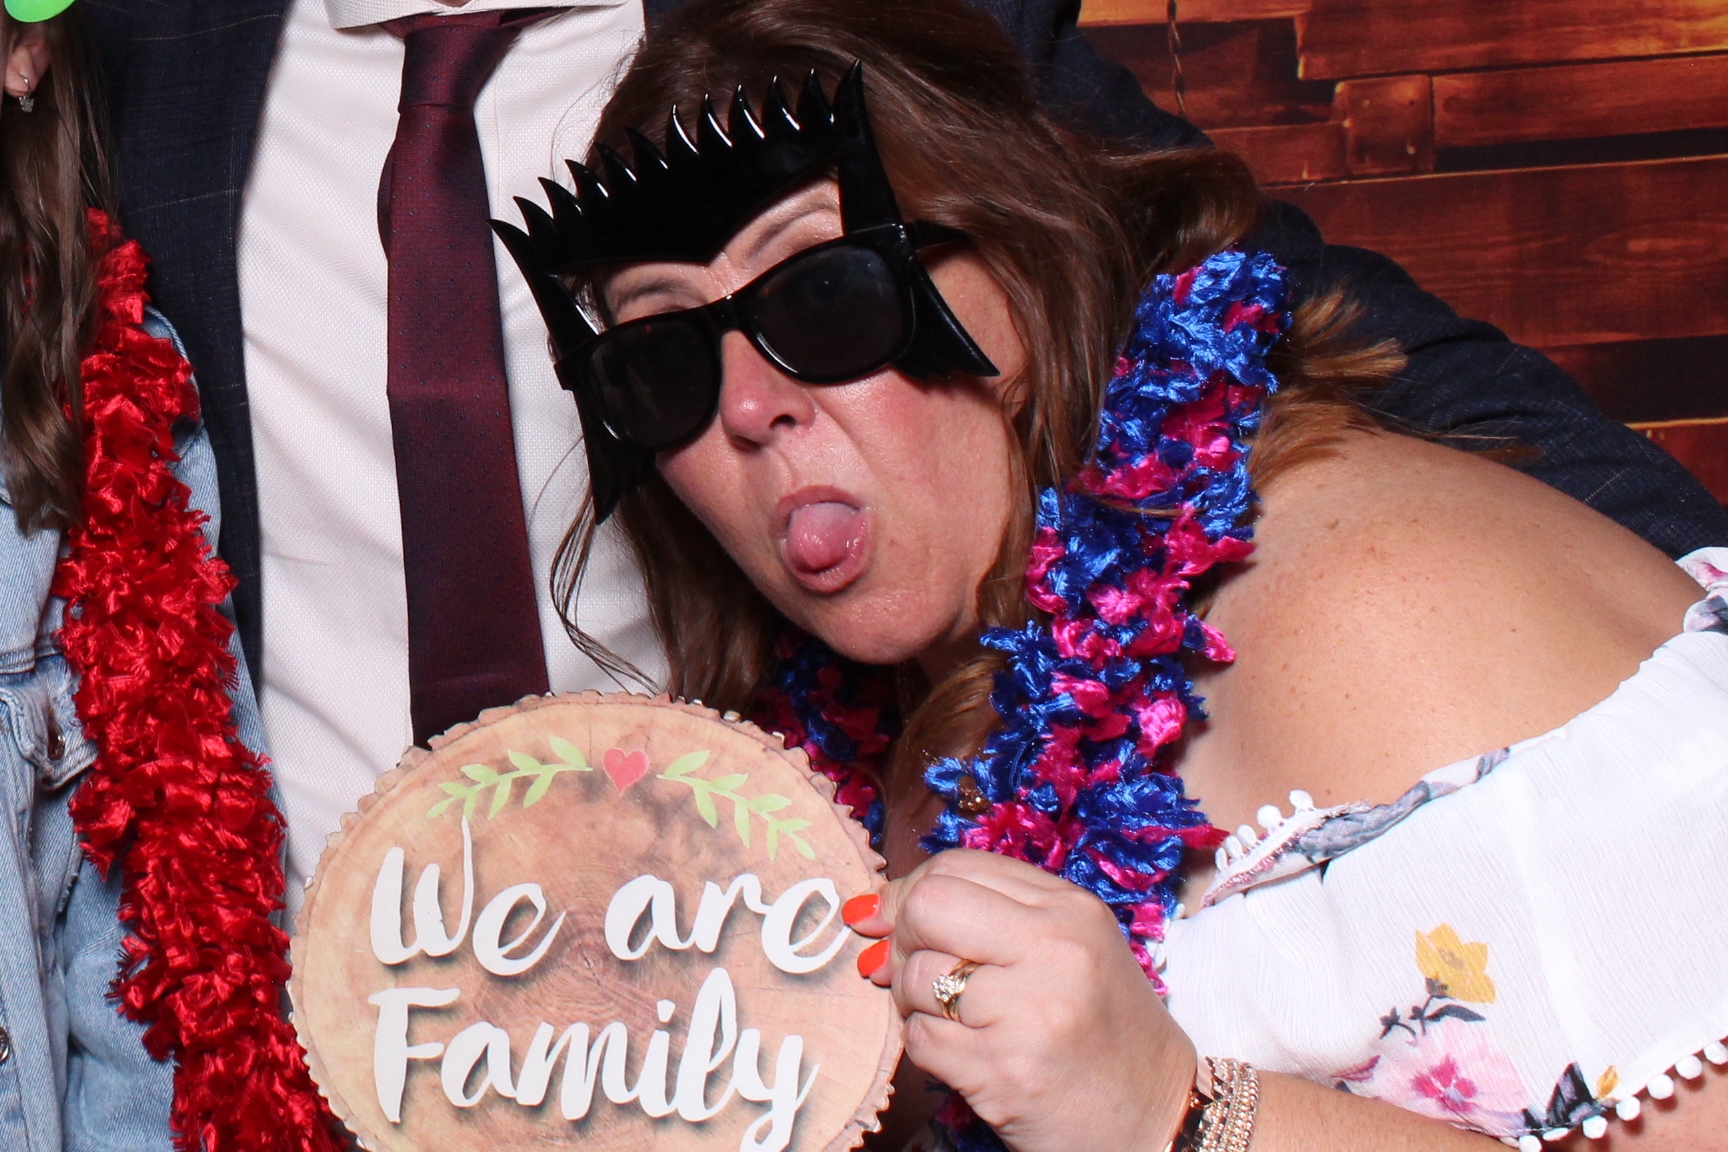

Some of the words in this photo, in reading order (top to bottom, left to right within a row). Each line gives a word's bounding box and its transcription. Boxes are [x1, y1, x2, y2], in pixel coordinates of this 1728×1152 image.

[370, 815, 566, 977] We
[604, 873, 852, 974] are
[367, 967, 820, 1152] Family
